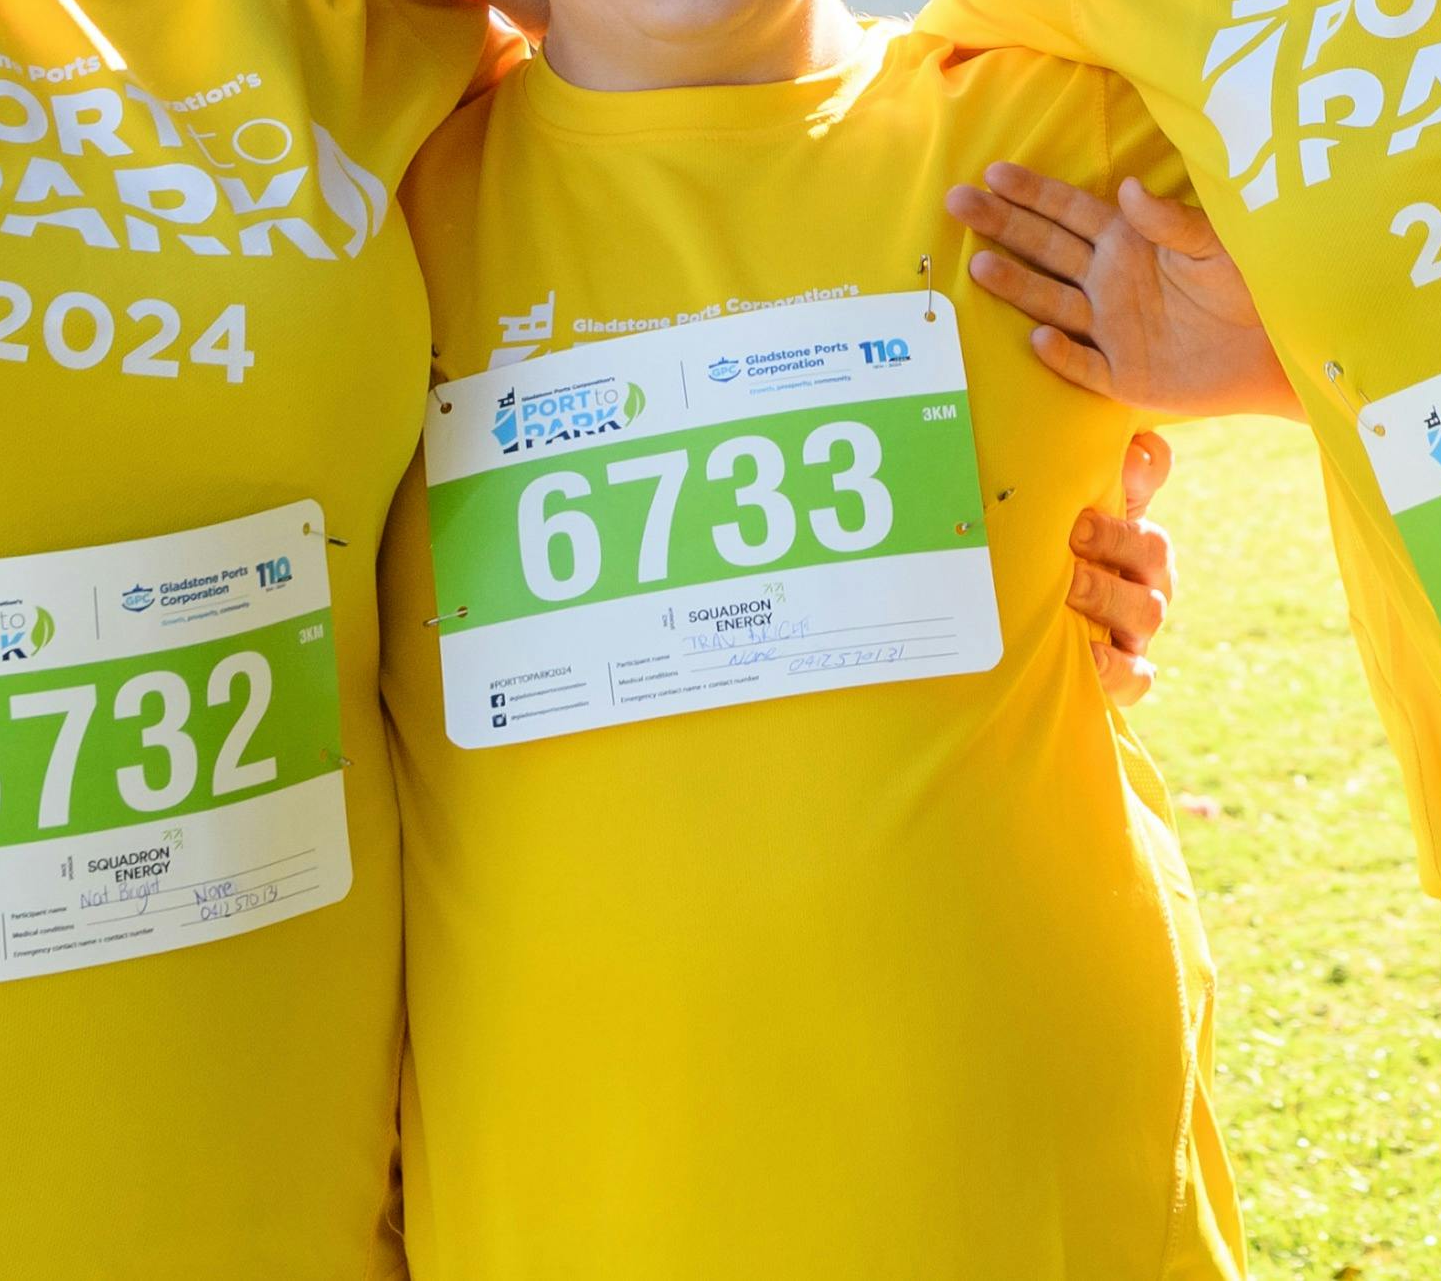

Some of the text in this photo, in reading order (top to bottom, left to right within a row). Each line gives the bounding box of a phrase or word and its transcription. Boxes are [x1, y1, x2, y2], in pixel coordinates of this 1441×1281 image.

[28, 55, 102, 83] Ports
[186, 118, 292, 168] to
[573, 317, 671, 332] Gladstone
[677, 303, 721, 325] Ports
[746, 341, 849, 366] Gladstone Ports
[859, 338, 909, 364] 110
[712, 366, 737, 377] GPC
[747, 358, 825, 379] Corporation
[523, 389, 619, 421] PORT to
[922, 404, 957, 421] 3KM
[524, 405, 622, 449] PARK
[518, 421, 893, 602] 6733
[160, 566, 248, 594] Gladstone Ports
[256, 556, 292, 588] 110
[126, 594, 151, 607] GPC
[161, 584, 229, 607] Corporation
[0, 612, 26, 630] to
[689, 599, 771, 623] SQUADRON
[716, 613, 773, 632] ENERGY
[298, 623, 324, 645] 3KM
[490, 665, 572, 690] #PORTTOPARK2024
[88, 846, 170, 873] SQUADRON
[115, 861, 171, 883] ENERGY
